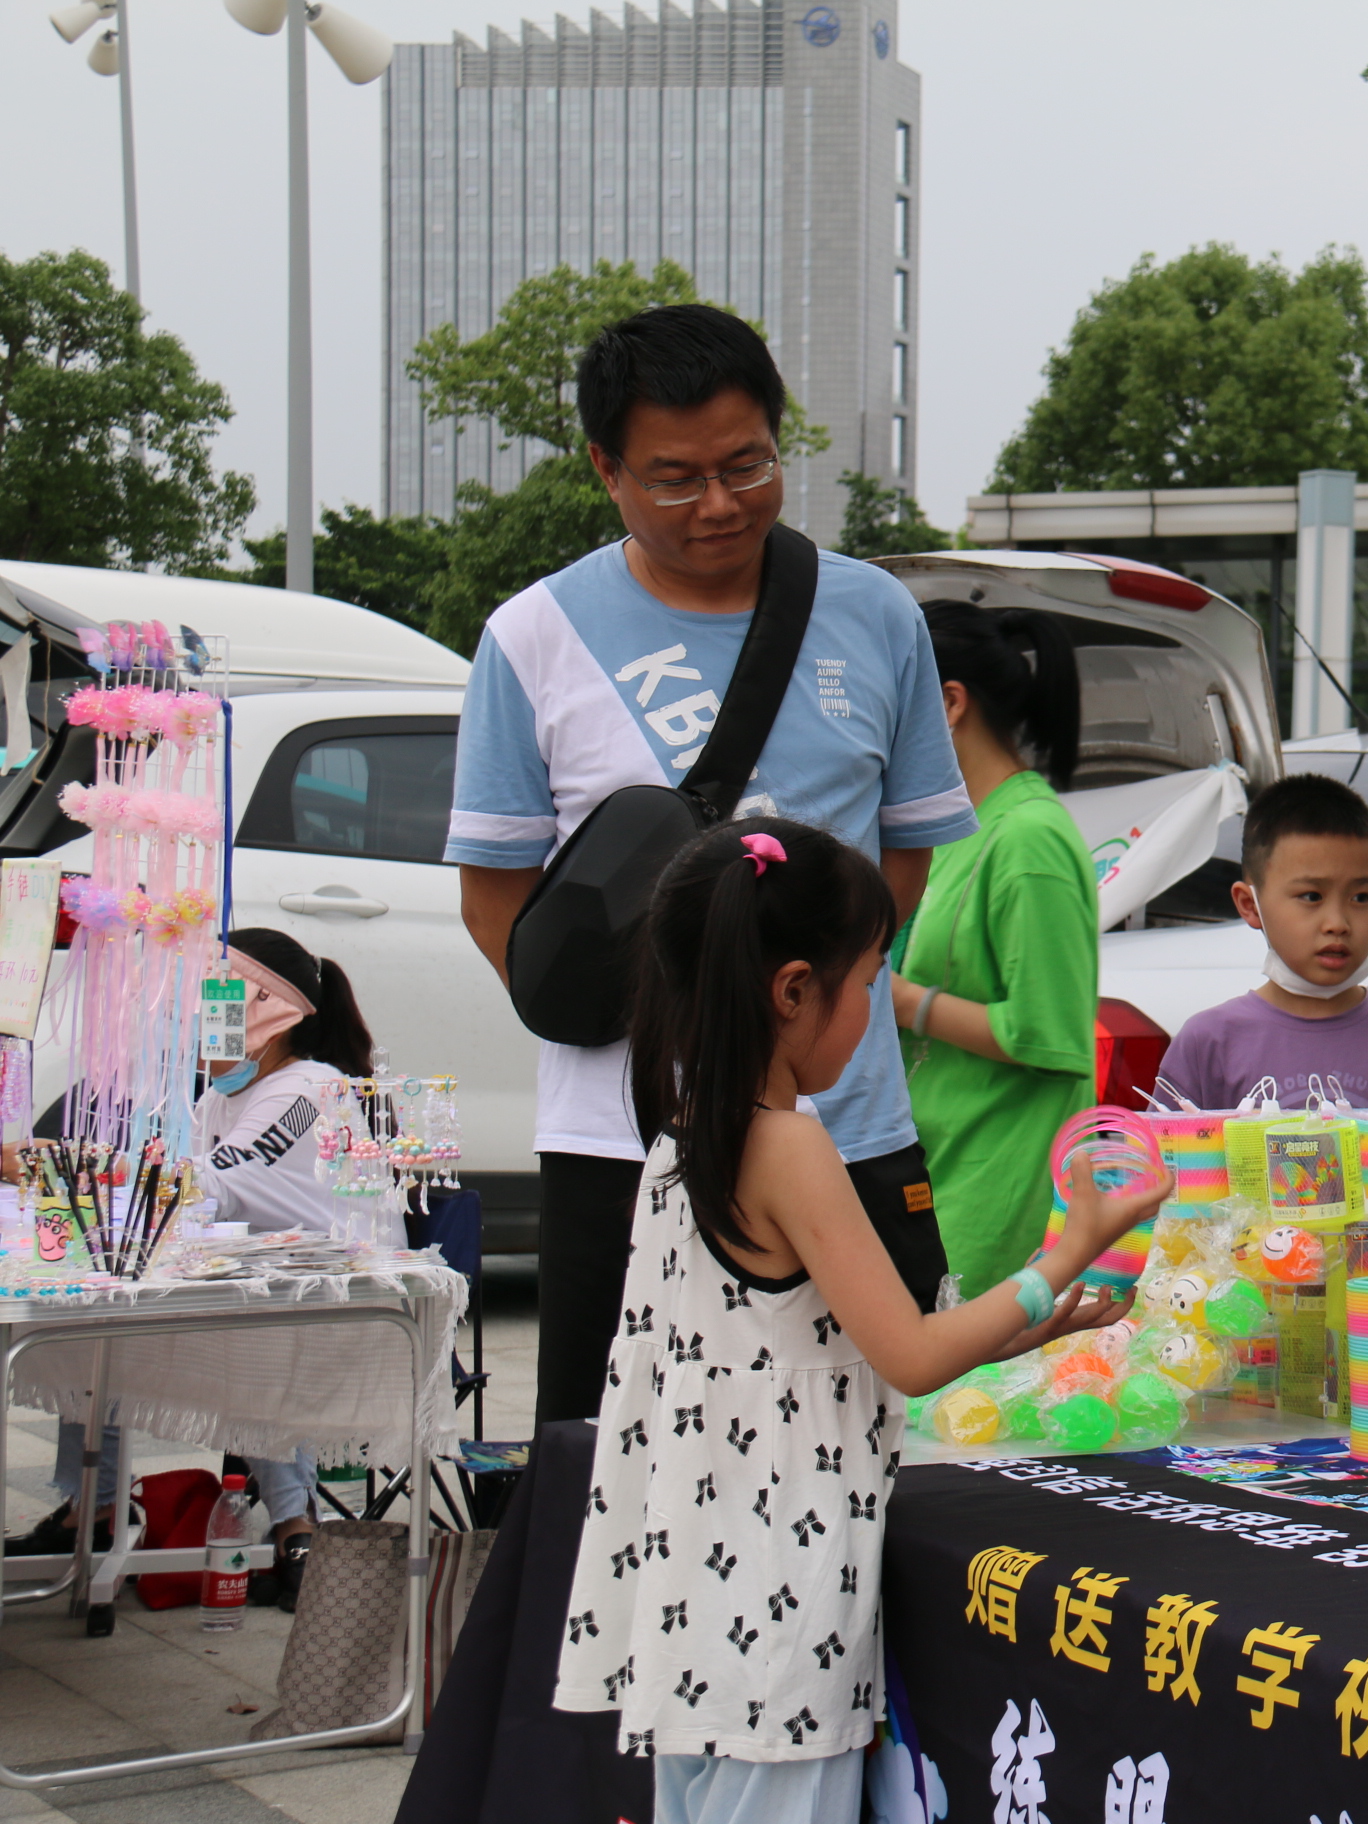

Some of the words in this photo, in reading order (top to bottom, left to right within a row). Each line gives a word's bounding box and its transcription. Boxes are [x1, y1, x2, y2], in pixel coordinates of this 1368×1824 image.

[815, 659, 847, 668] TUENDY
[816, 668, 843, 677] AUINO
[817, 678, 840, 686] EILLO
[818, 687, 846, 697] ANFOR
